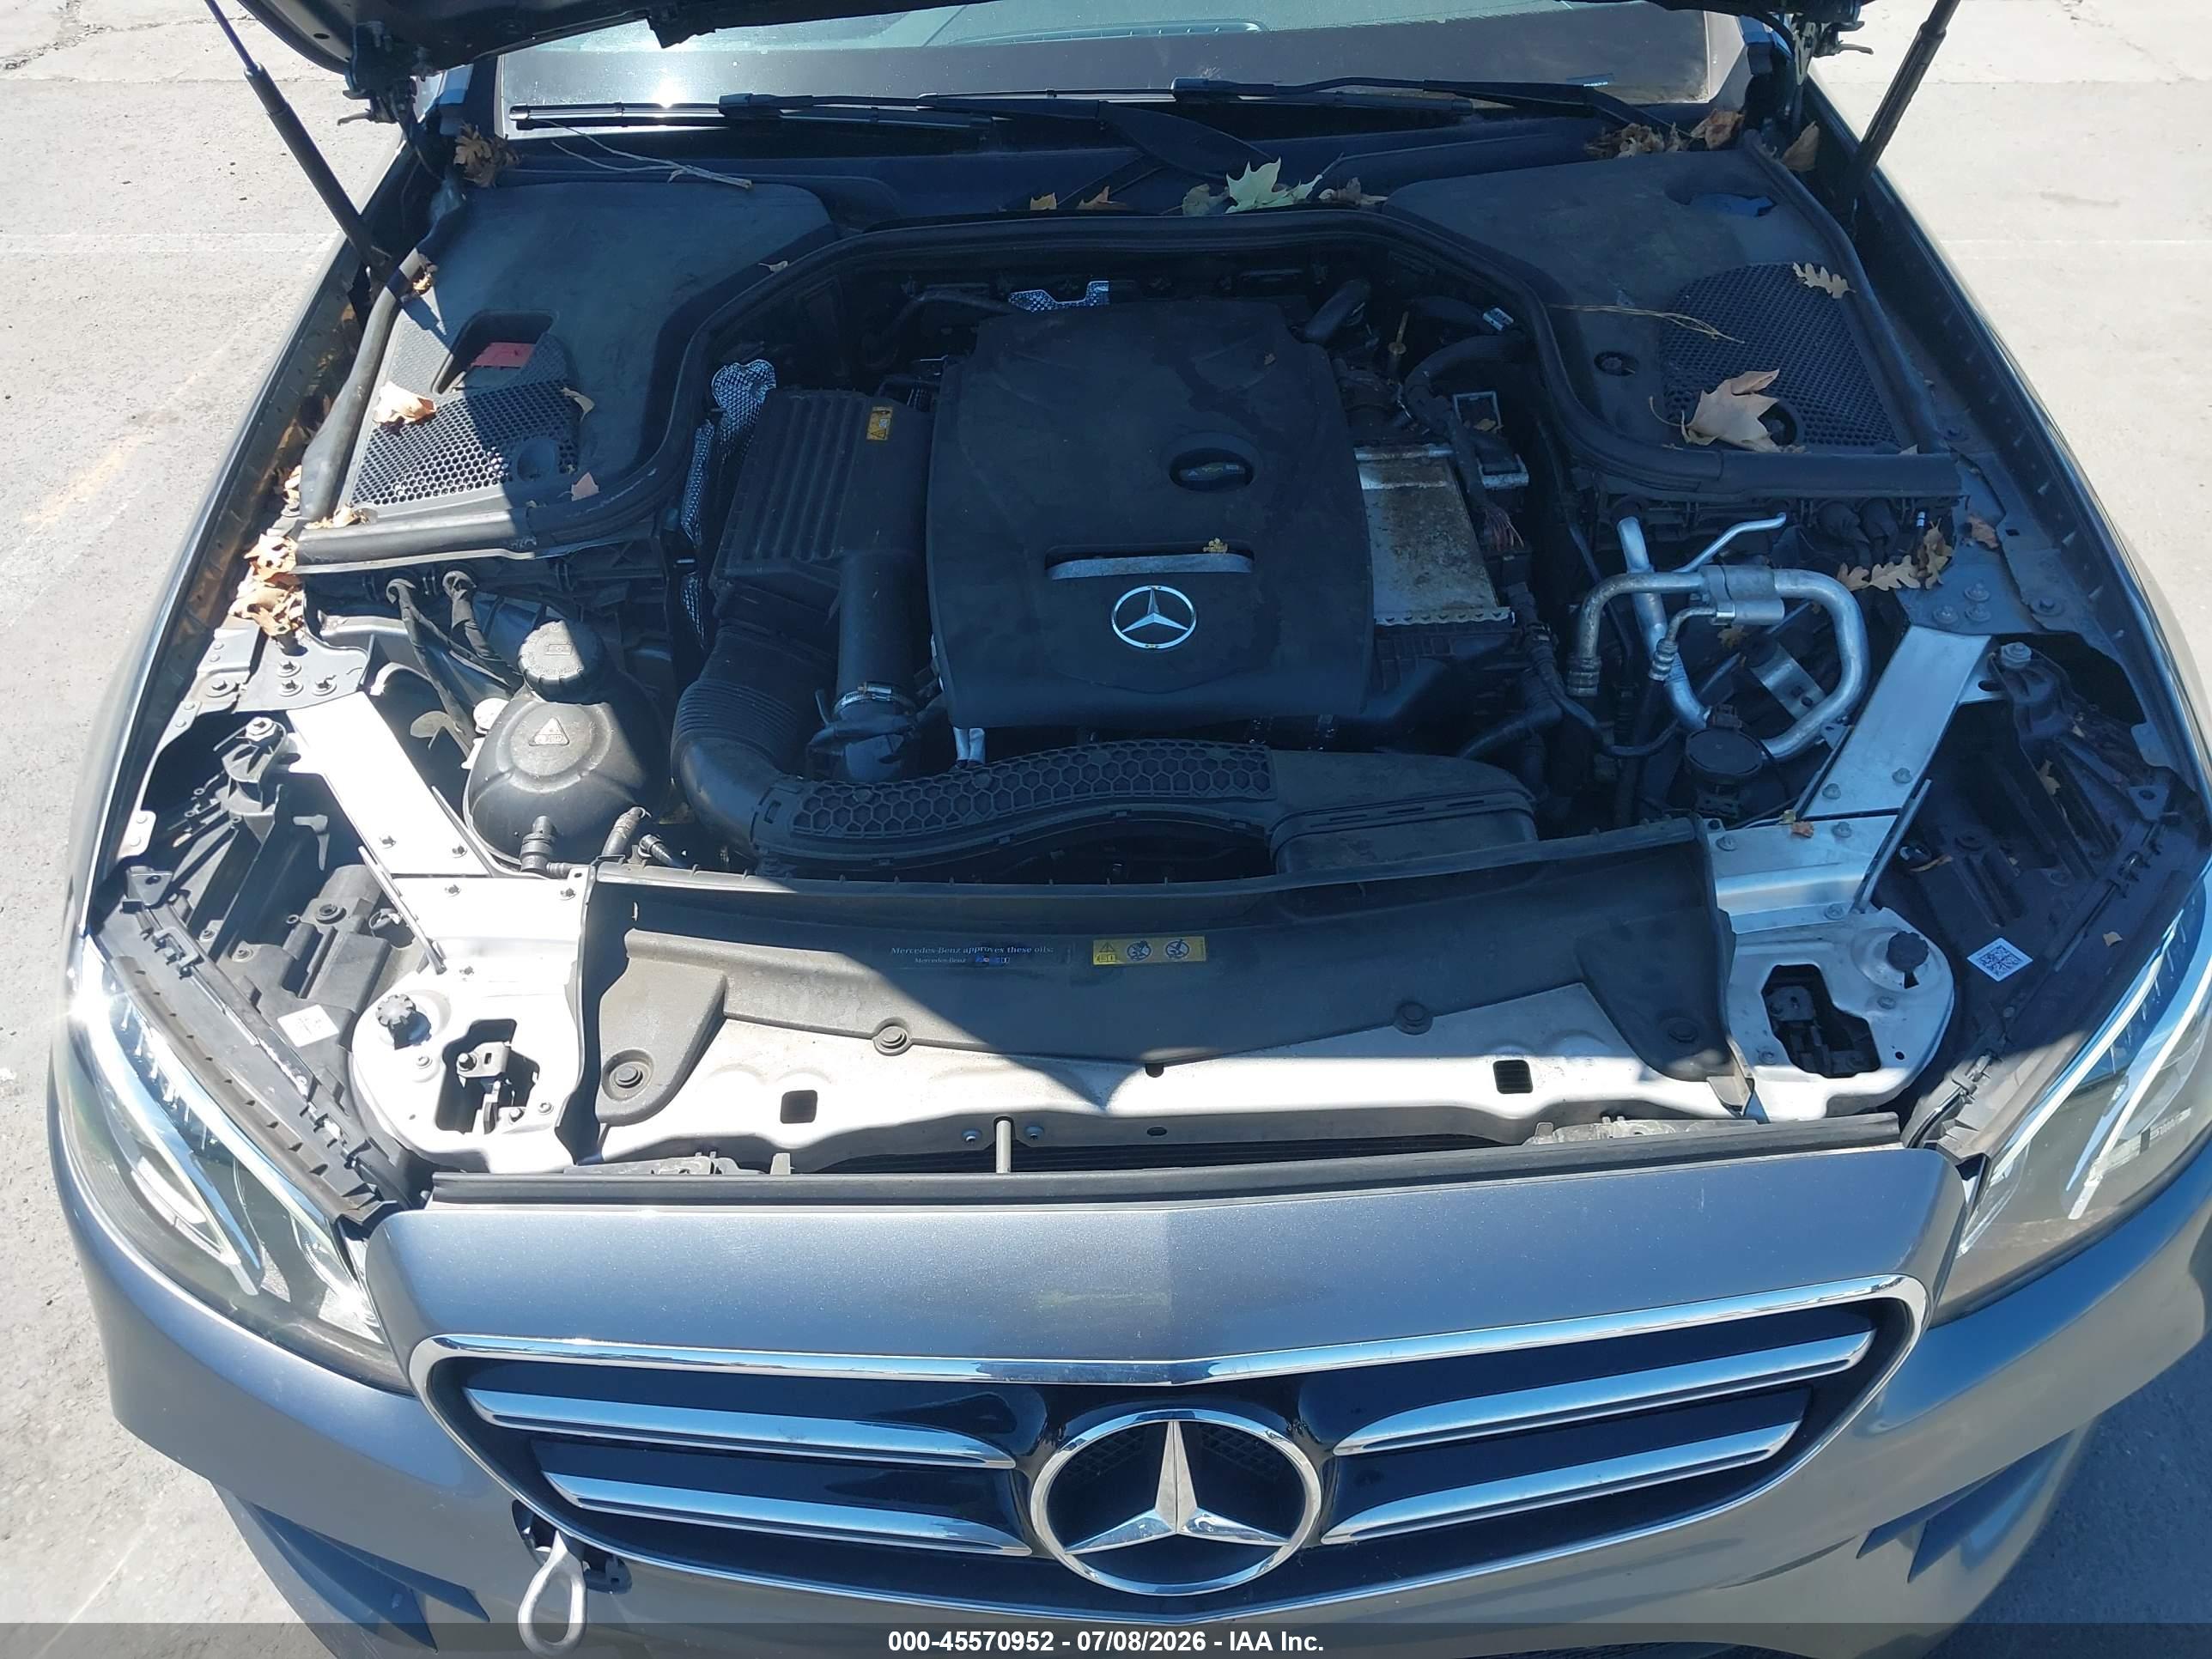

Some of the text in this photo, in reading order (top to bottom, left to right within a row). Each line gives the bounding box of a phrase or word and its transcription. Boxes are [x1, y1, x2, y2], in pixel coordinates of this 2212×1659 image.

[963, 946, 1005, 956] approves
[1007, 945, 1032, 954] these
[1034, 945, 1054, 954] oils:
